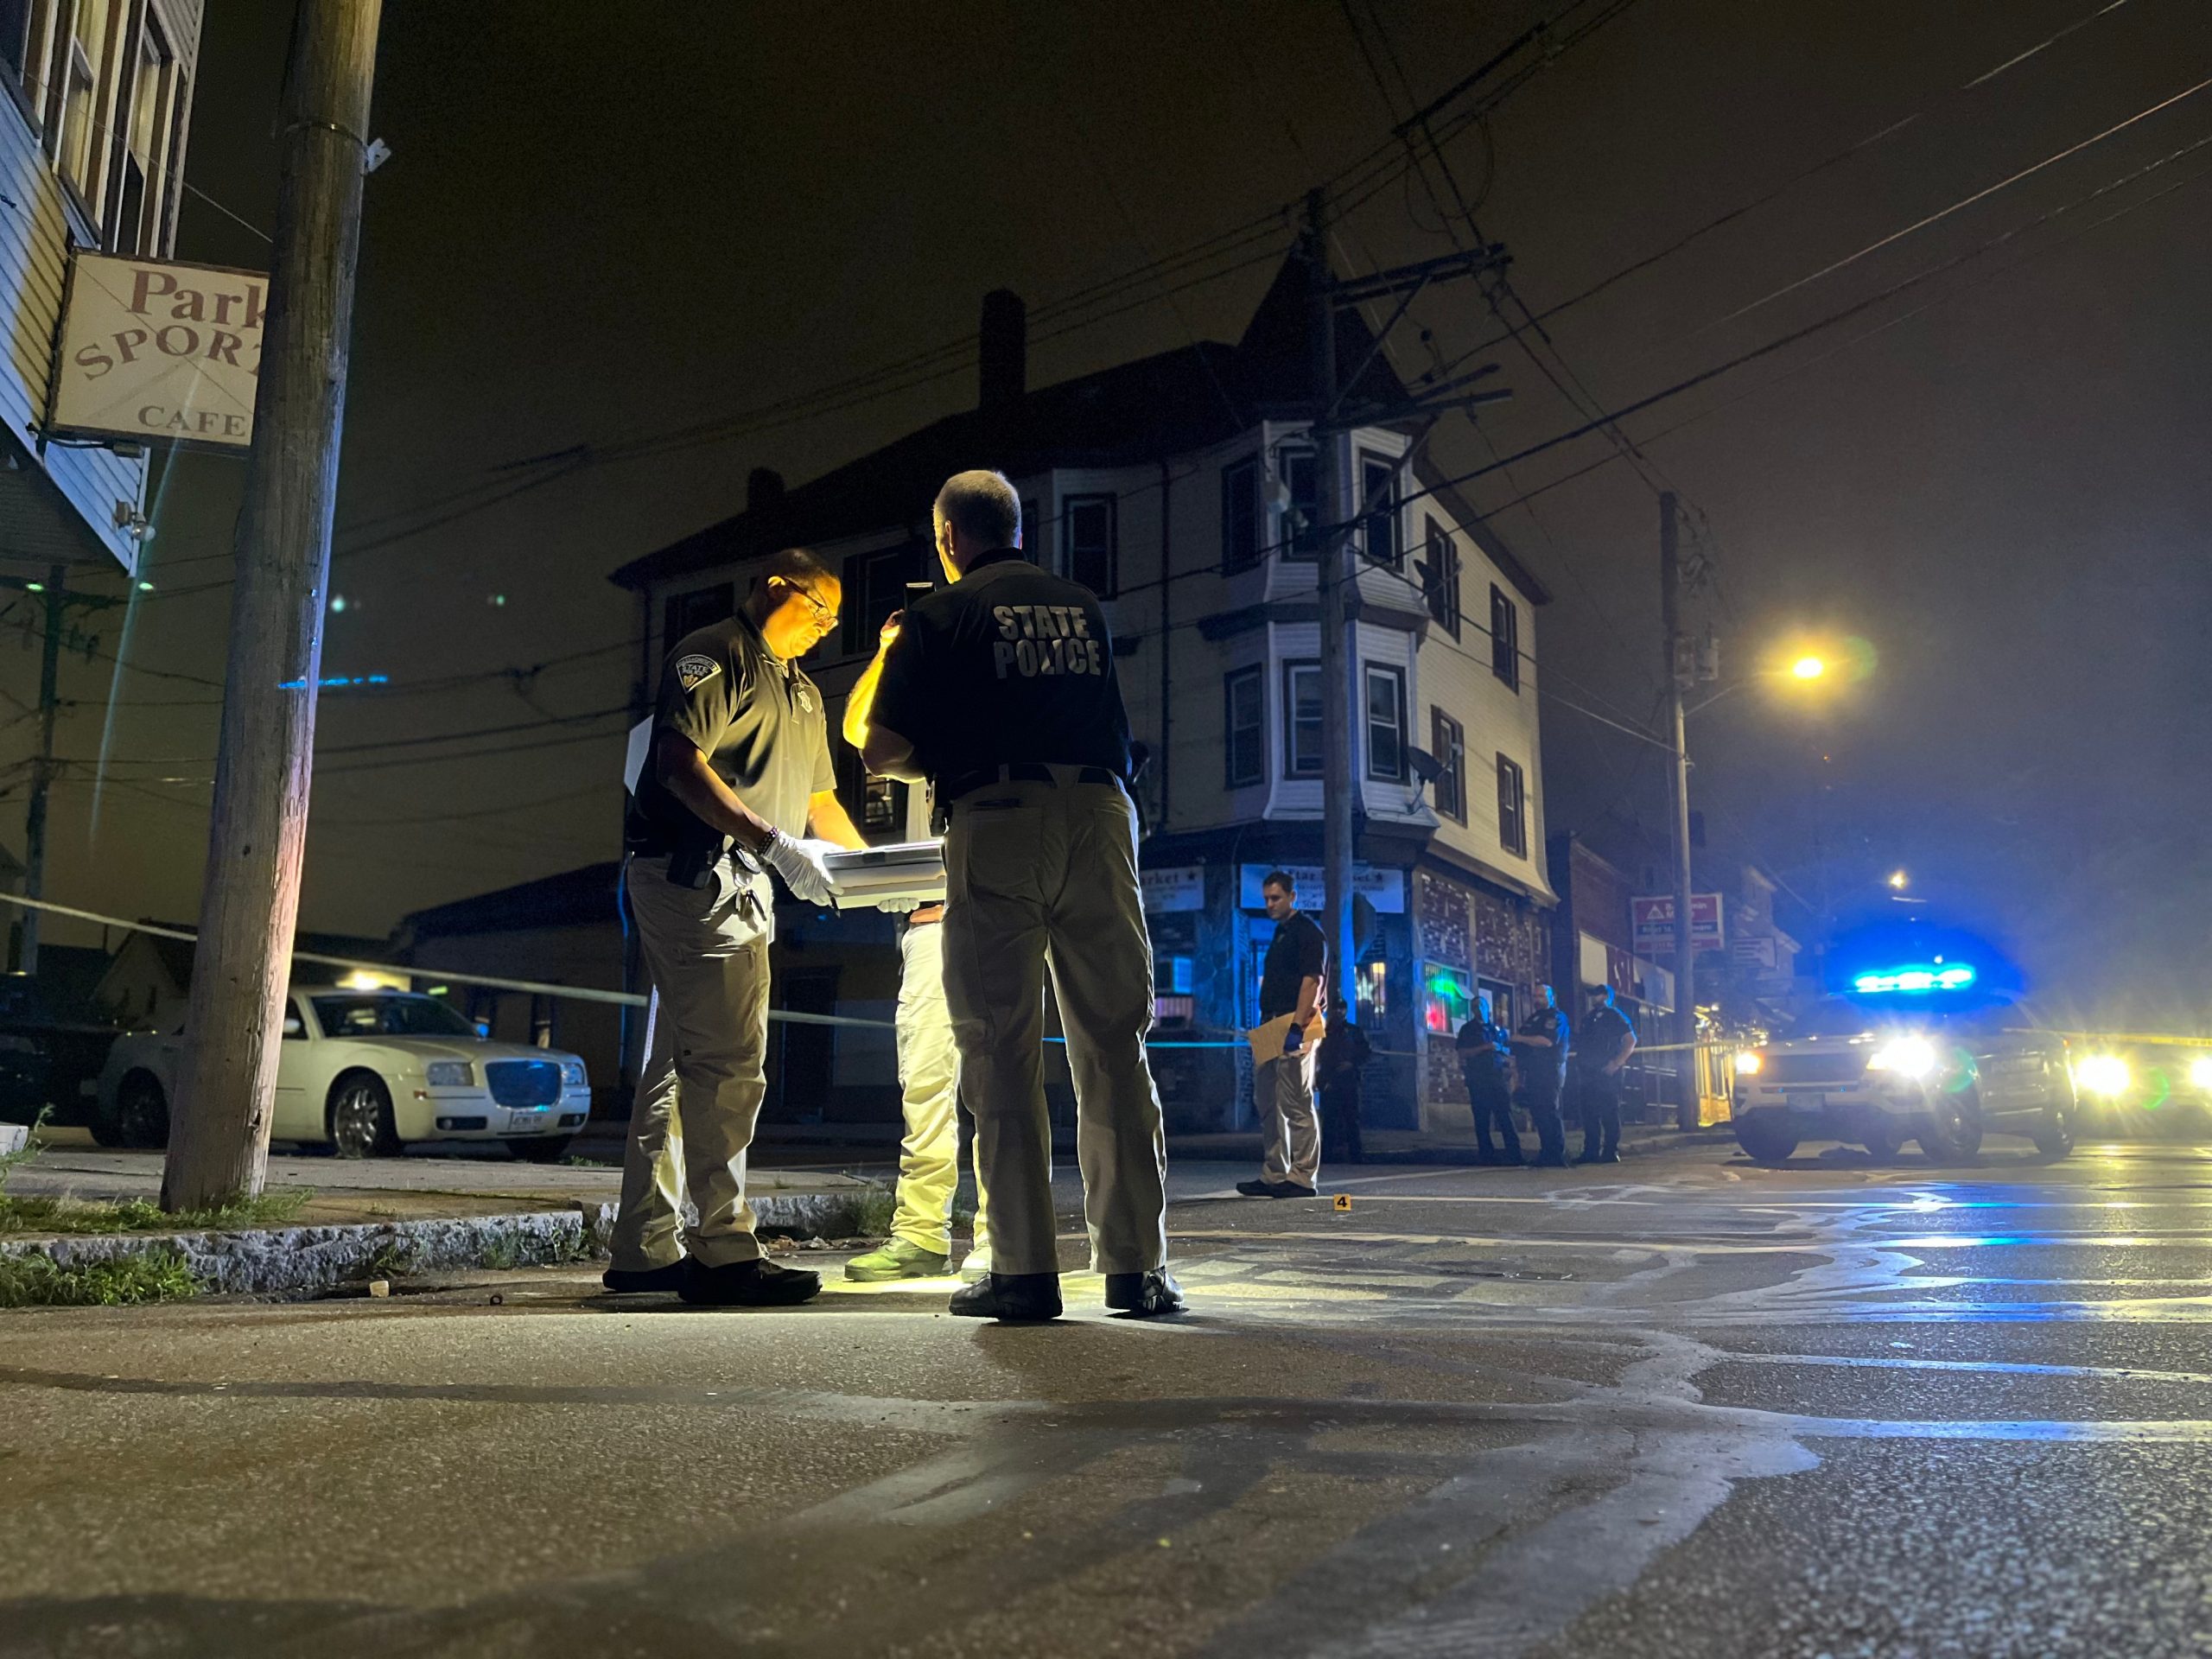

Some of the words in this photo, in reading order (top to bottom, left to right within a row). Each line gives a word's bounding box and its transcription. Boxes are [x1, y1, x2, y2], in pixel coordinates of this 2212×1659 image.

[138, 405, 246, 436] CAFE
[993, 605, 1090, 639] STATE
[993, 638, 1102, 679] POLICE
[1337, 1196, 1348, 1207] 4
